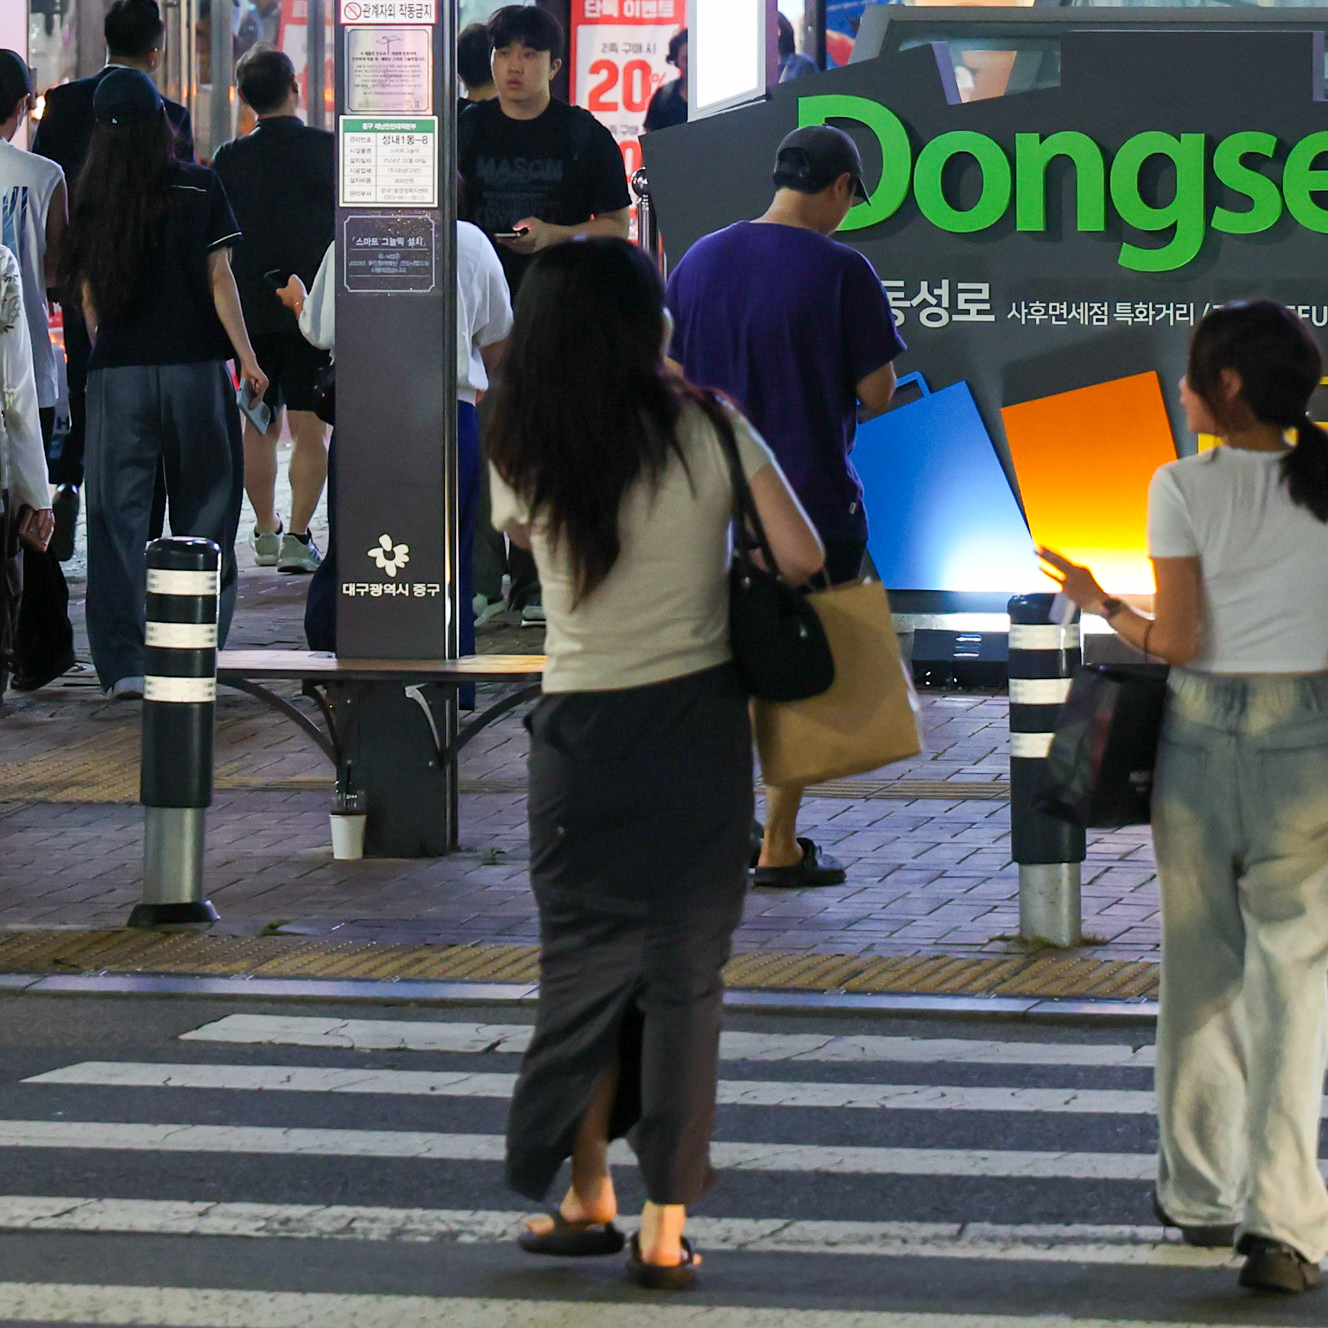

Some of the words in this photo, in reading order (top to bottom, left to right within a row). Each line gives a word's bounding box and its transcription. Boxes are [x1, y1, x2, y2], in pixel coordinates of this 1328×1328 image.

[363, 3, 396, 19] 관계자외
[399, 3, 432, 19] 작동금지
[623, 0, 676, 18] 이벤트
[623, 42, 642, 54] 구매
[648, 43, 657, 54] 시
[382, 135, 429, 145] 성내1동-8
[1006, 301, 1110, 326] 사후면세점
[1112, 302, 1195, 327] 특화거리
[342, 583, 410, 597] 대구광역시
[412, 583, 441, 597] 중구
